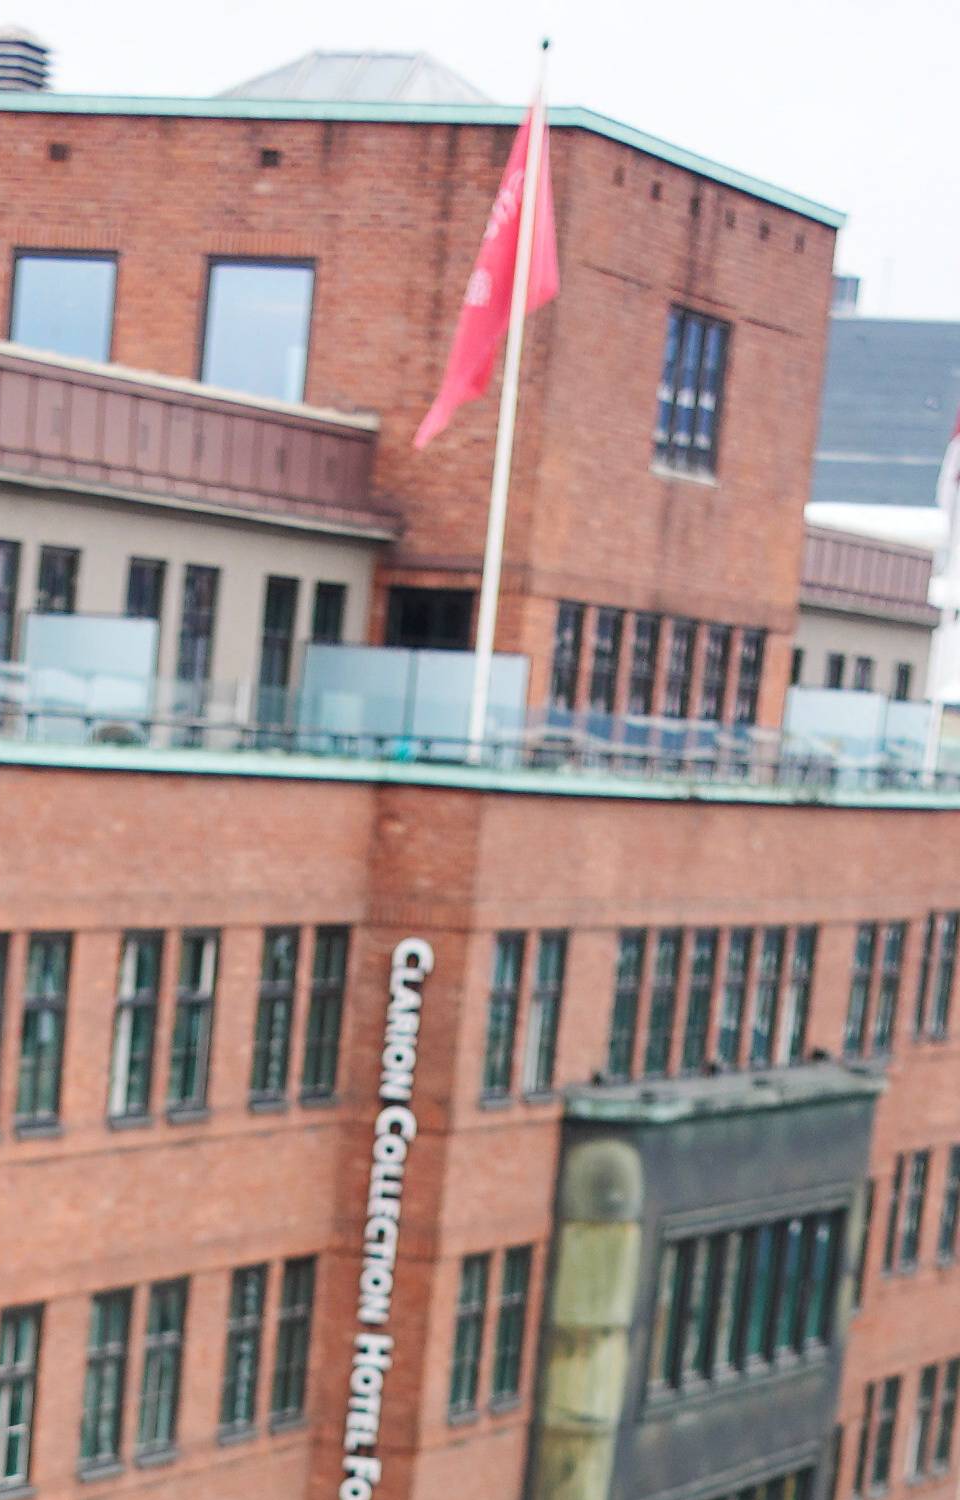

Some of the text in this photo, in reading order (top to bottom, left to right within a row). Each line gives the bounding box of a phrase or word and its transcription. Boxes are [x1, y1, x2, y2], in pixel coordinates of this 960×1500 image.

[378, 936, 435, 1100] CLARION
[356, 1104, 418, 1325] COLLECTION
[344, 1332, 395, 1452] HOTEL
